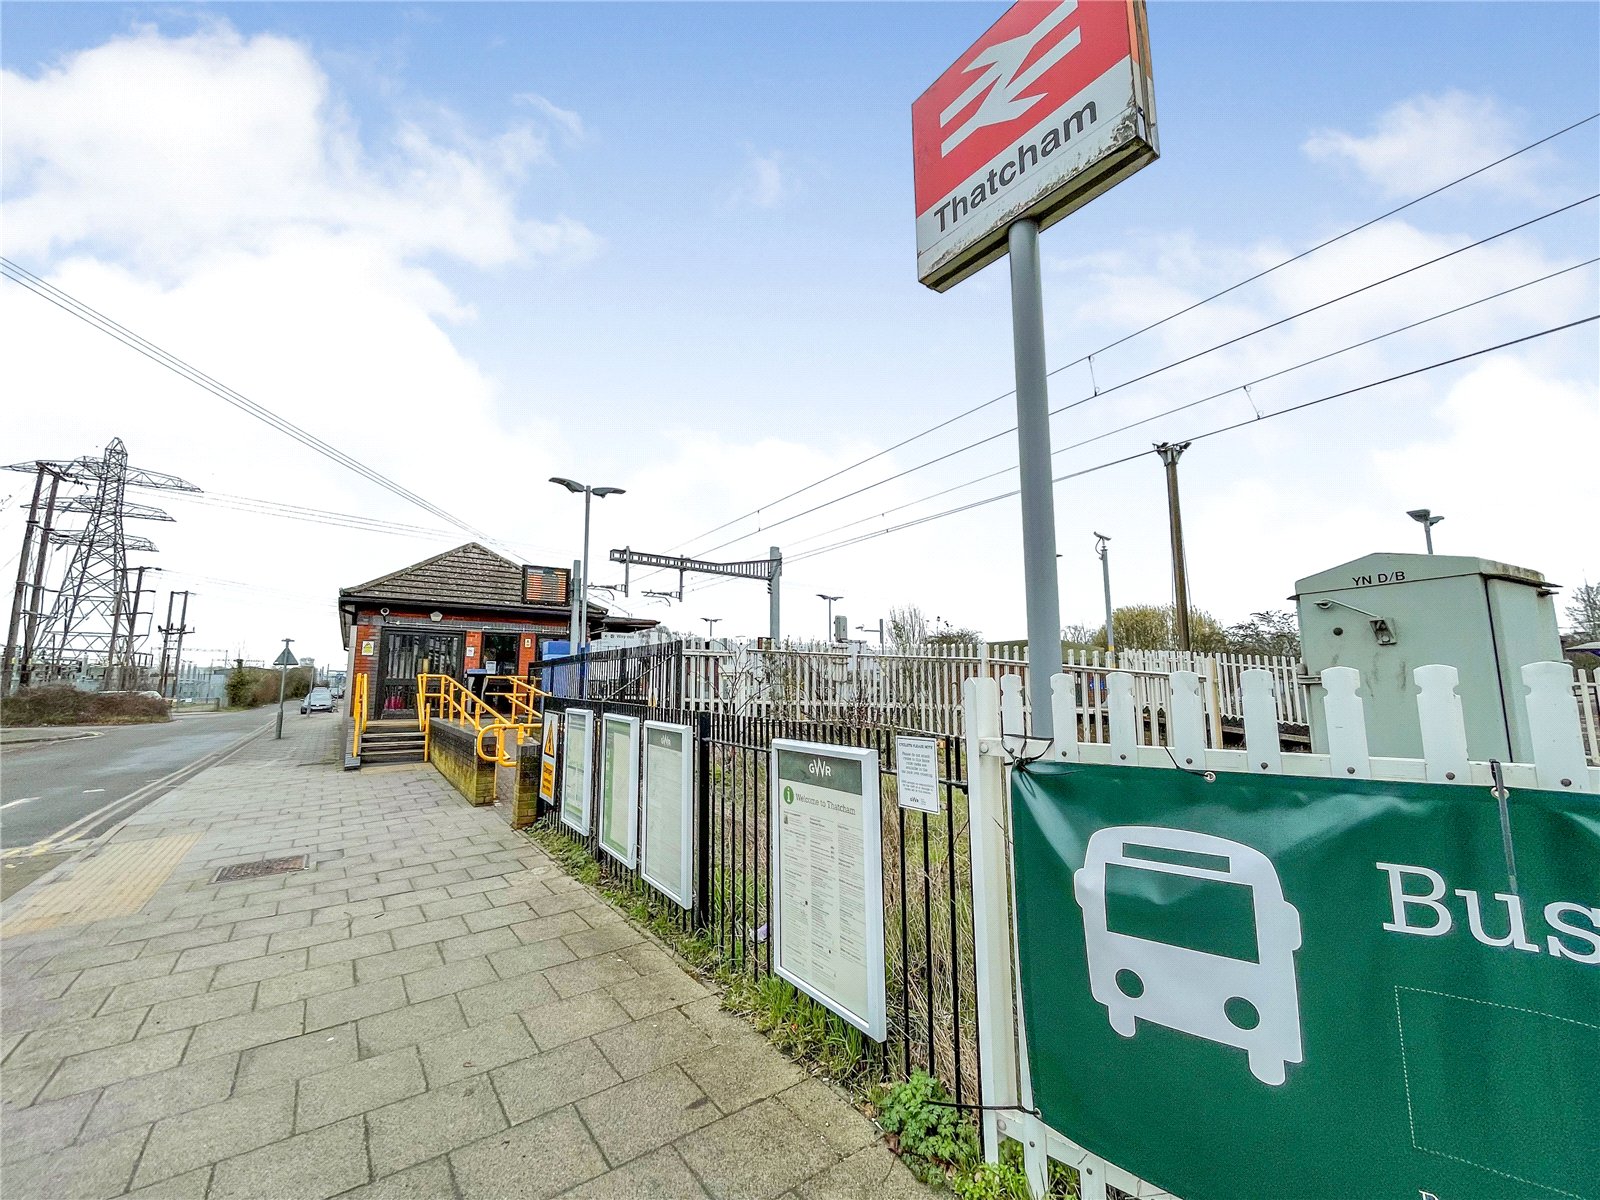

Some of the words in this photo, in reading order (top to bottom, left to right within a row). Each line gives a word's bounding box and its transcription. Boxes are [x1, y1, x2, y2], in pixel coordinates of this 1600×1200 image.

[933, 100, 1098, 233] Thatcham
[1352, 575, 1372, 586] YN
[1377, 571, 1406, 584] D/B
[808, 757, 831, 778] GWR
[795, 793, 820, 806] Welcome
[820, 800, 826, 808] to
[827, 800, 856, 815] Thatcham
[1376, 862, 1600, 965] Bus
